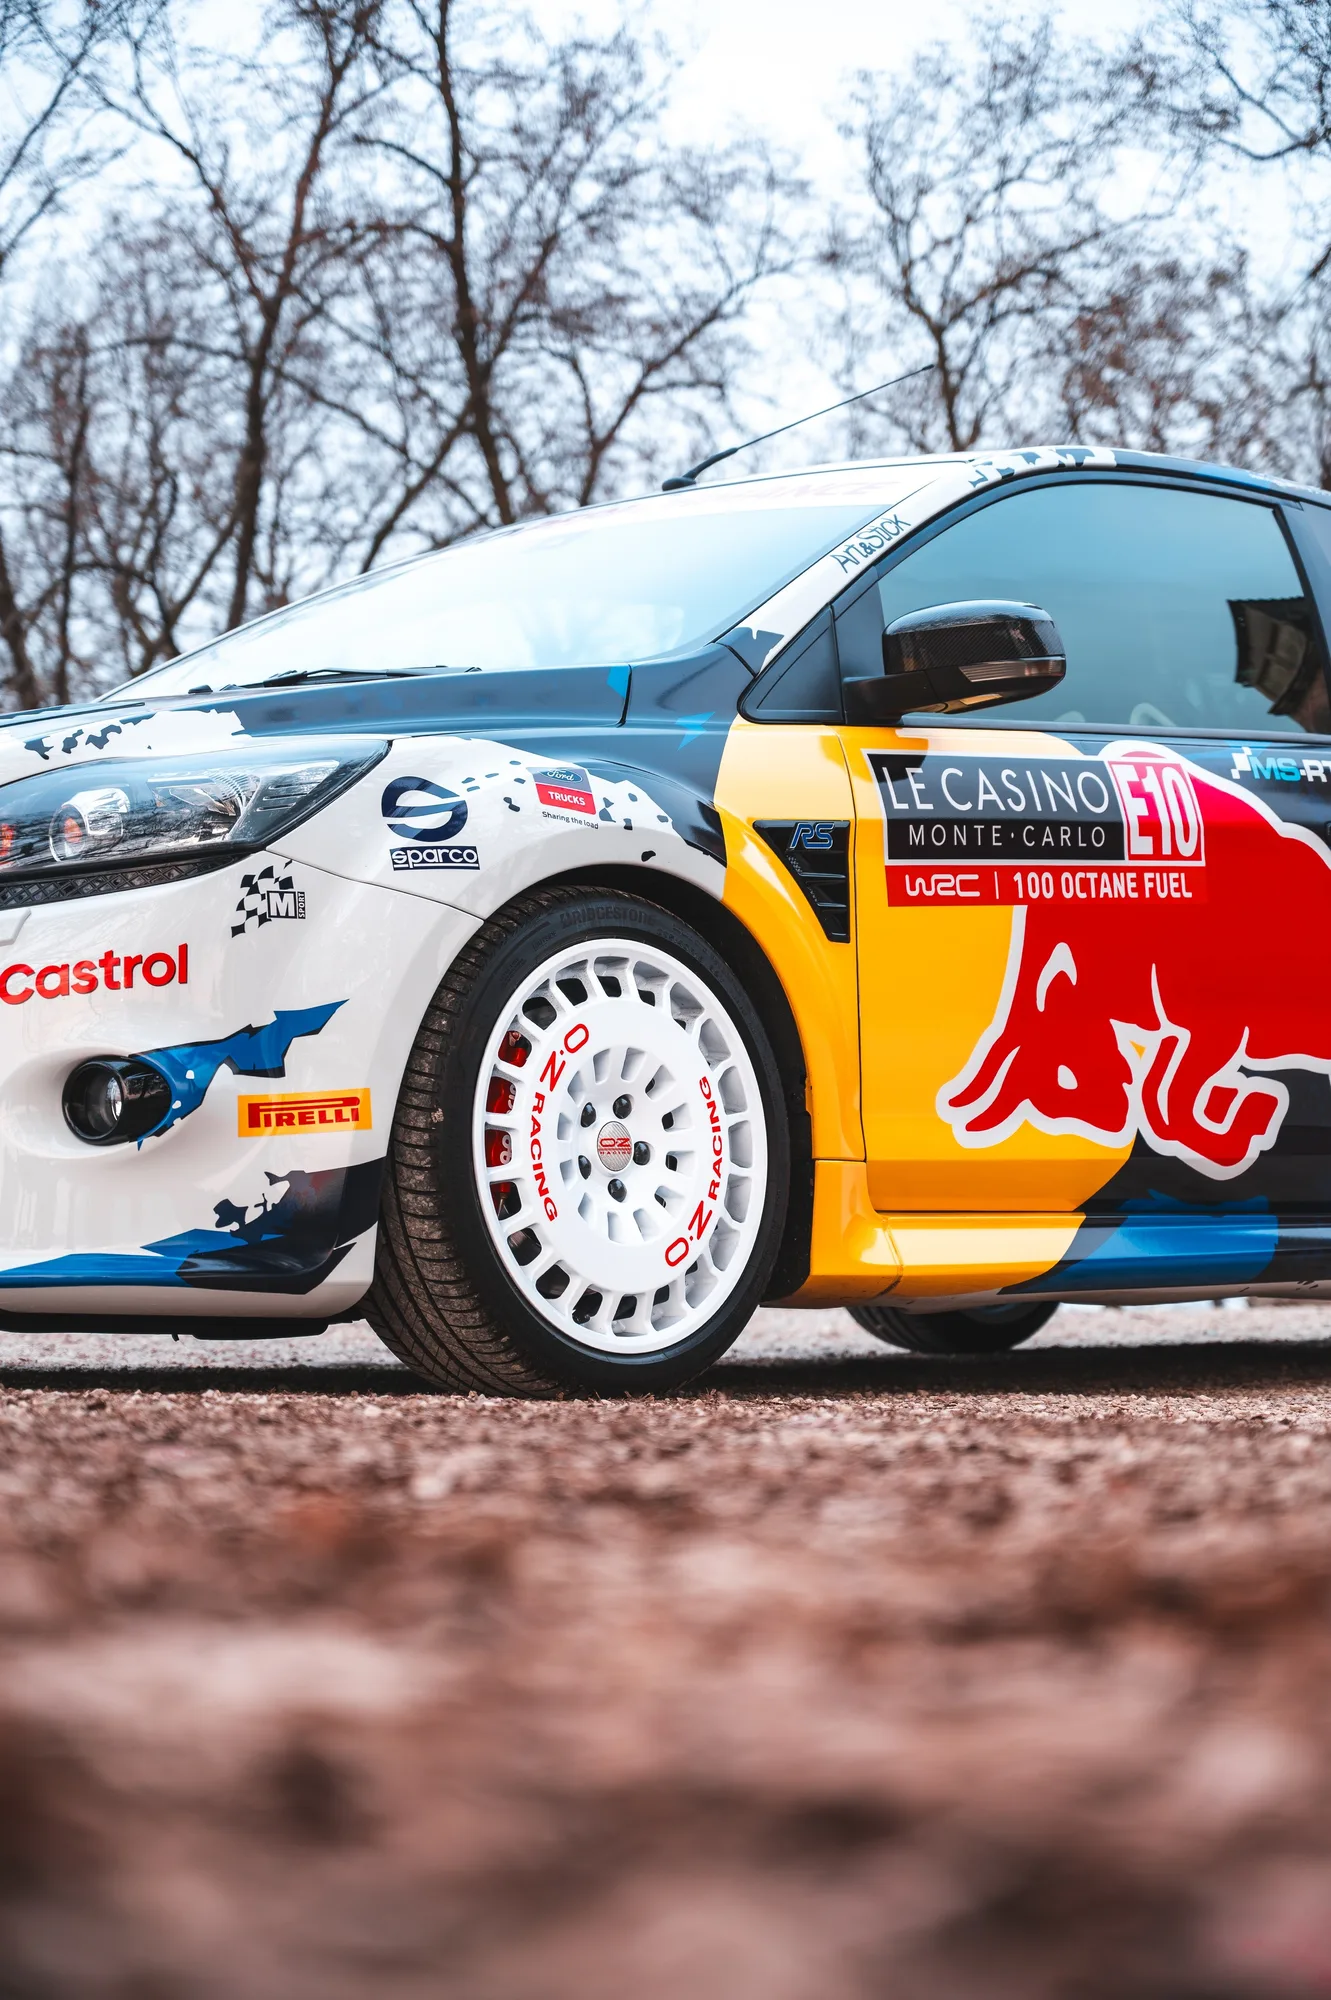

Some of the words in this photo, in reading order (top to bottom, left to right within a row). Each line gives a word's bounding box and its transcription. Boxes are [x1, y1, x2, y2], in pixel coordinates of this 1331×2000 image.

[546, 769, 575, 782] Ford
[547, 791, 586, 806] TRUCKS
[882, 766, 934, 810] LE
[941, 767, 1109, 814] CASINO
[541, 811, 570, 823] Sharing
[571, 817, 583, 825] the
[583, 820, 599, 830] load
[1111, 763, 1199, 858] E10
[789, 822, 835, 850] RS
[391, 848, 478, 869] sparco
[904, 873, 981, 897] WRC
[1012, 871, 1054, 898] 100
[1060, 871, 1138, 899] OCTANE
[1143, 872, 1193, 899] FUEL
[298, 891, 306, 919] SPORT
[0, 943, 188, 1006] Castrol
[247, 1096, 361, 1129] PIRELLI
[699, 1076, 723, 1201] RACING
[530, 1091, 558, 1222] RACING
